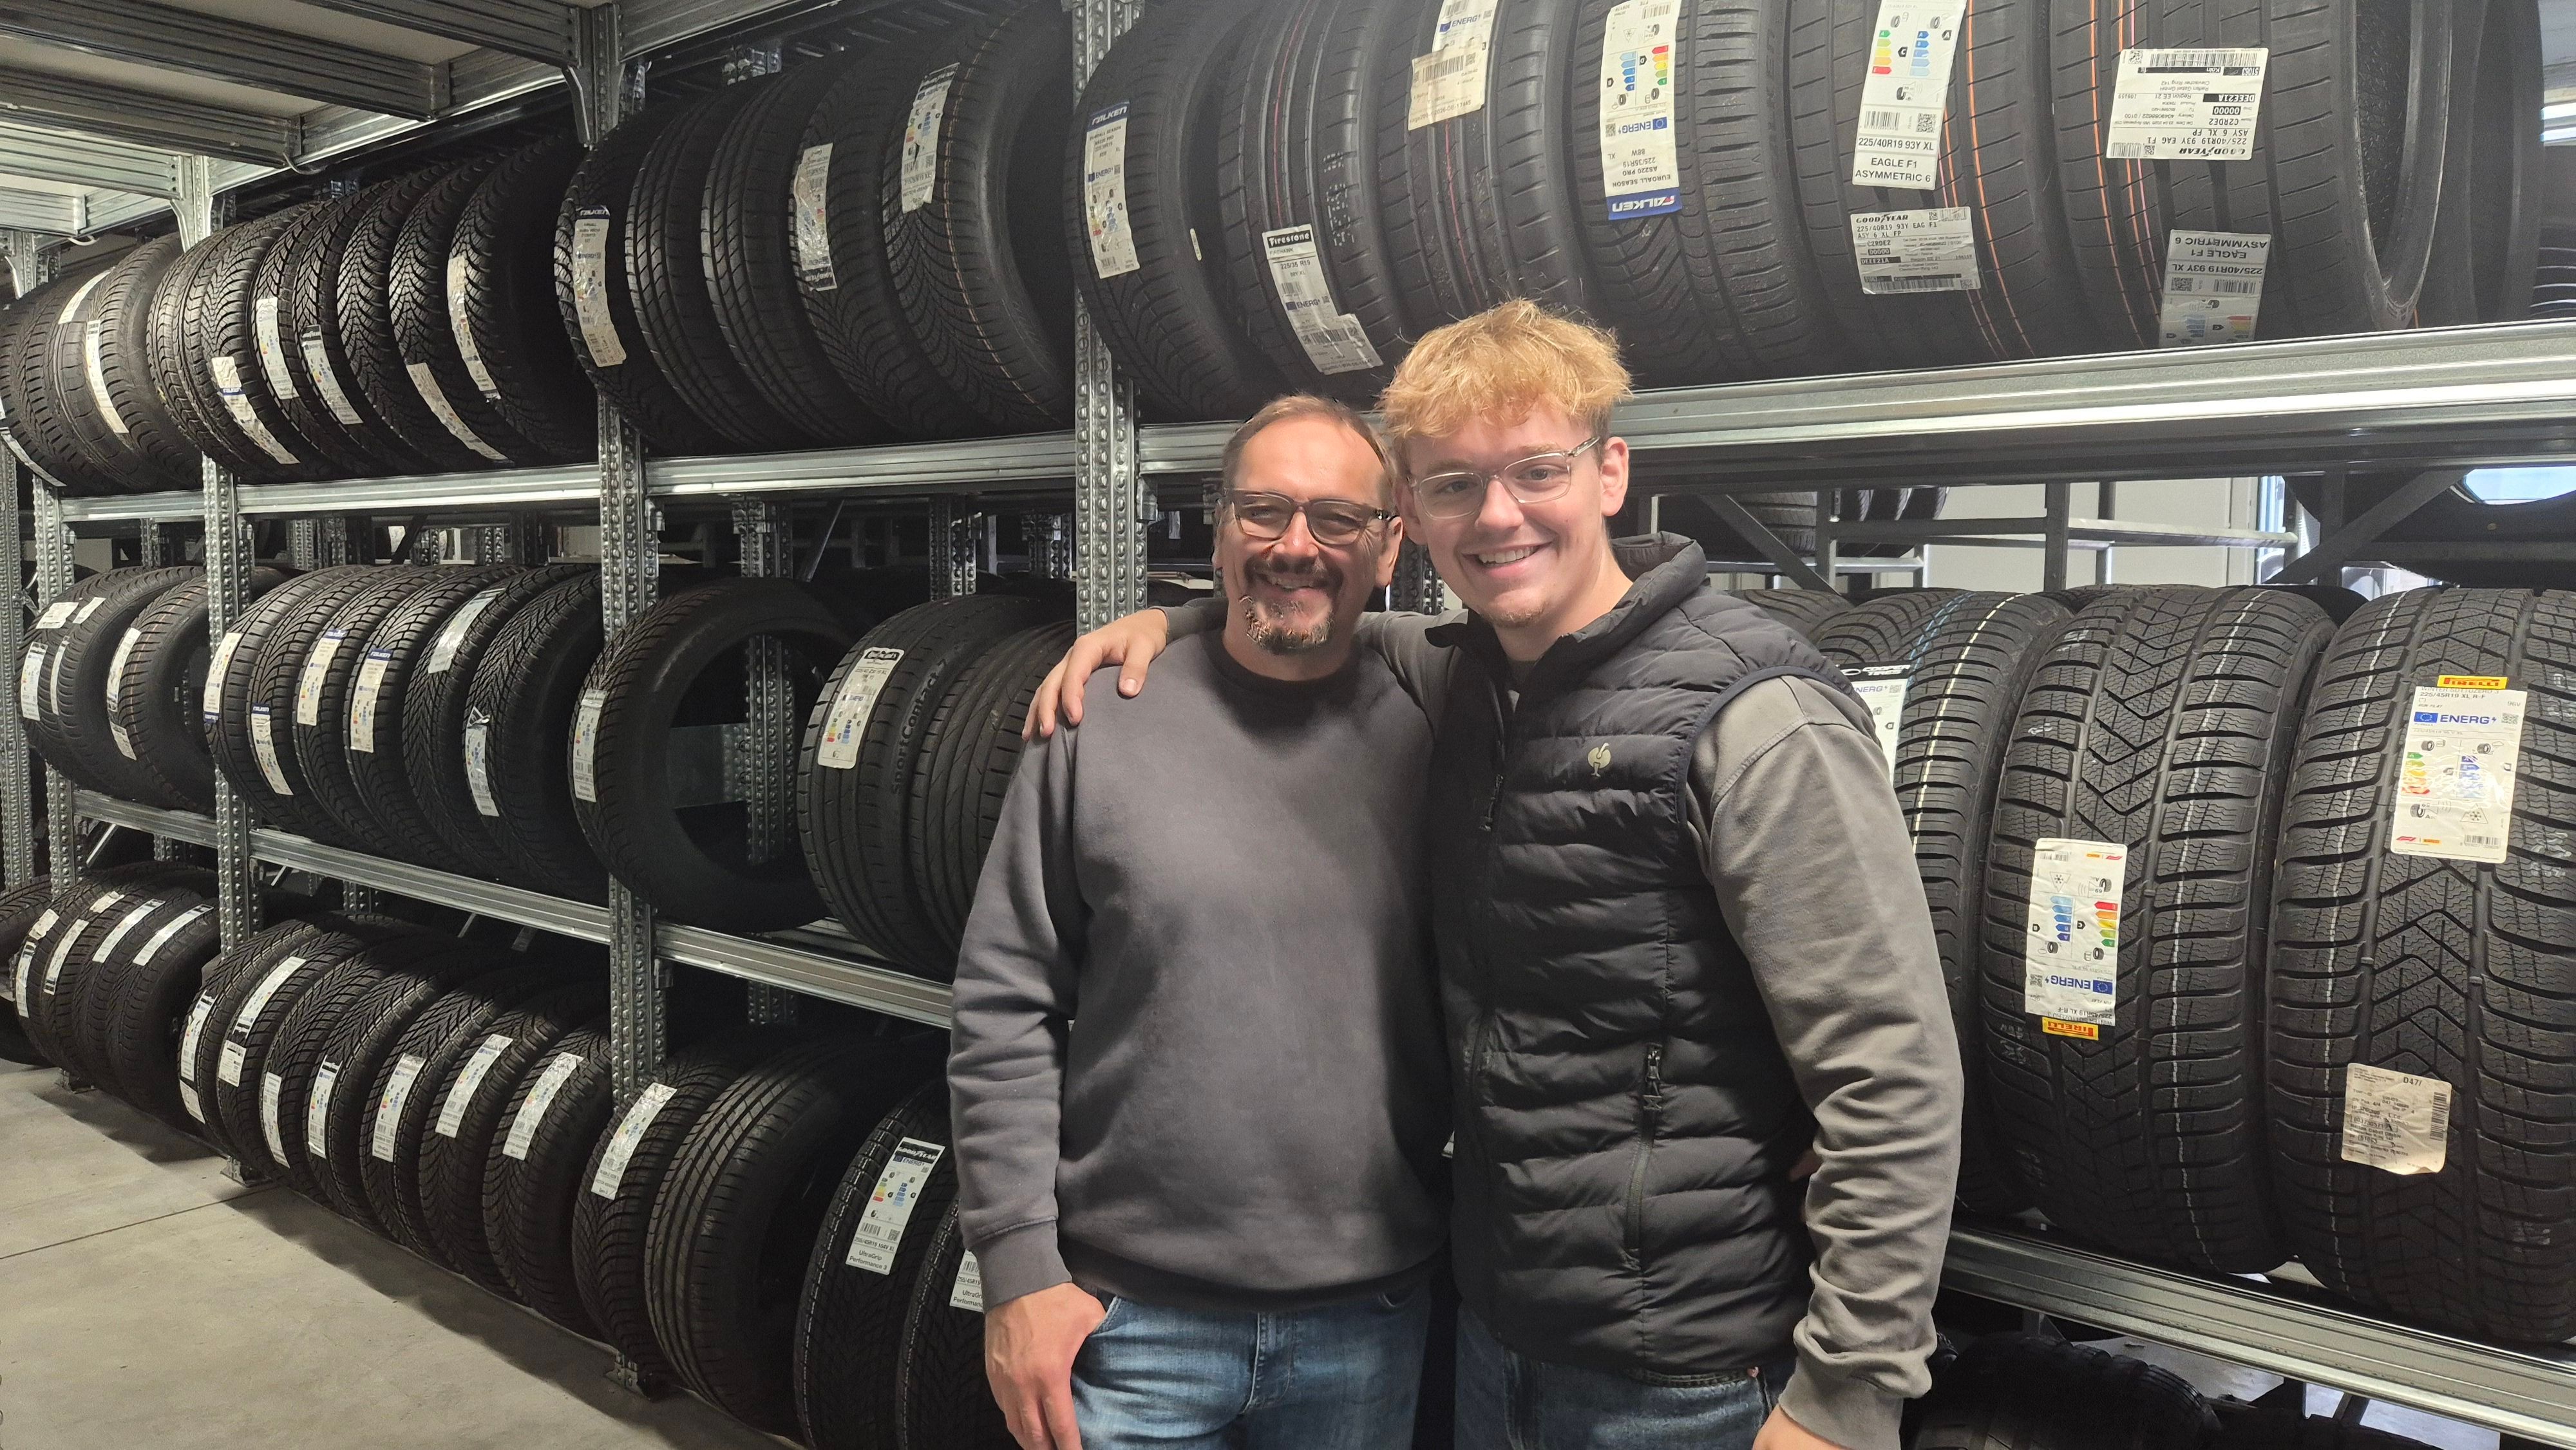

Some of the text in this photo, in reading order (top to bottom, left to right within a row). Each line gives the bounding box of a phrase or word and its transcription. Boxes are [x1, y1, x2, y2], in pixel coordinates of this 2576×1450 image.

[1092, 106, 1128, 126] FALKEN
[1622, 122, 1651, 134] ENERG
[1859, 138, 1934, 151] 225/40R19 93Y XL
[2179, 147, 2246, 157] GOODYEAR
[1623, 157, 1656, 168] 225/35R19
[1871, 158, 1904, 167] EAGLE
[1637, 166, 1658, 174] AS220
[1855, 169, 1922, 181] ASYMMETRIC
[1640, 174, 1671, 184] EUROALL
[1612, 196, 1675, 212] FALKEN
[1856, 214, 1908, 223] GOODYEAR
[1269, 232, 1310, 247] Firestone
[2185, 238, 2268, 249] ASYMMETRIC
[2207, 249, 2247, 259] EAGLE
[1280, 261, 1299, 270] 225/35
[2208, 265, 2263, 275] 225/40R19
[1296, 299, 1319, 309] ENERG
[2444, 677, 2501, 686] PIRELLI
[2440, 715, 2490, 724] ENERG
[2050, 975, 2091, 990] ENERG
[2047, 1021, 2094, 1037] PIRELLI
[859, 1250, 882, 1261] UltraGrip
[850, 1256, 883, 1269] Performance
[962, 1290, 983, 1299] UltraGr
